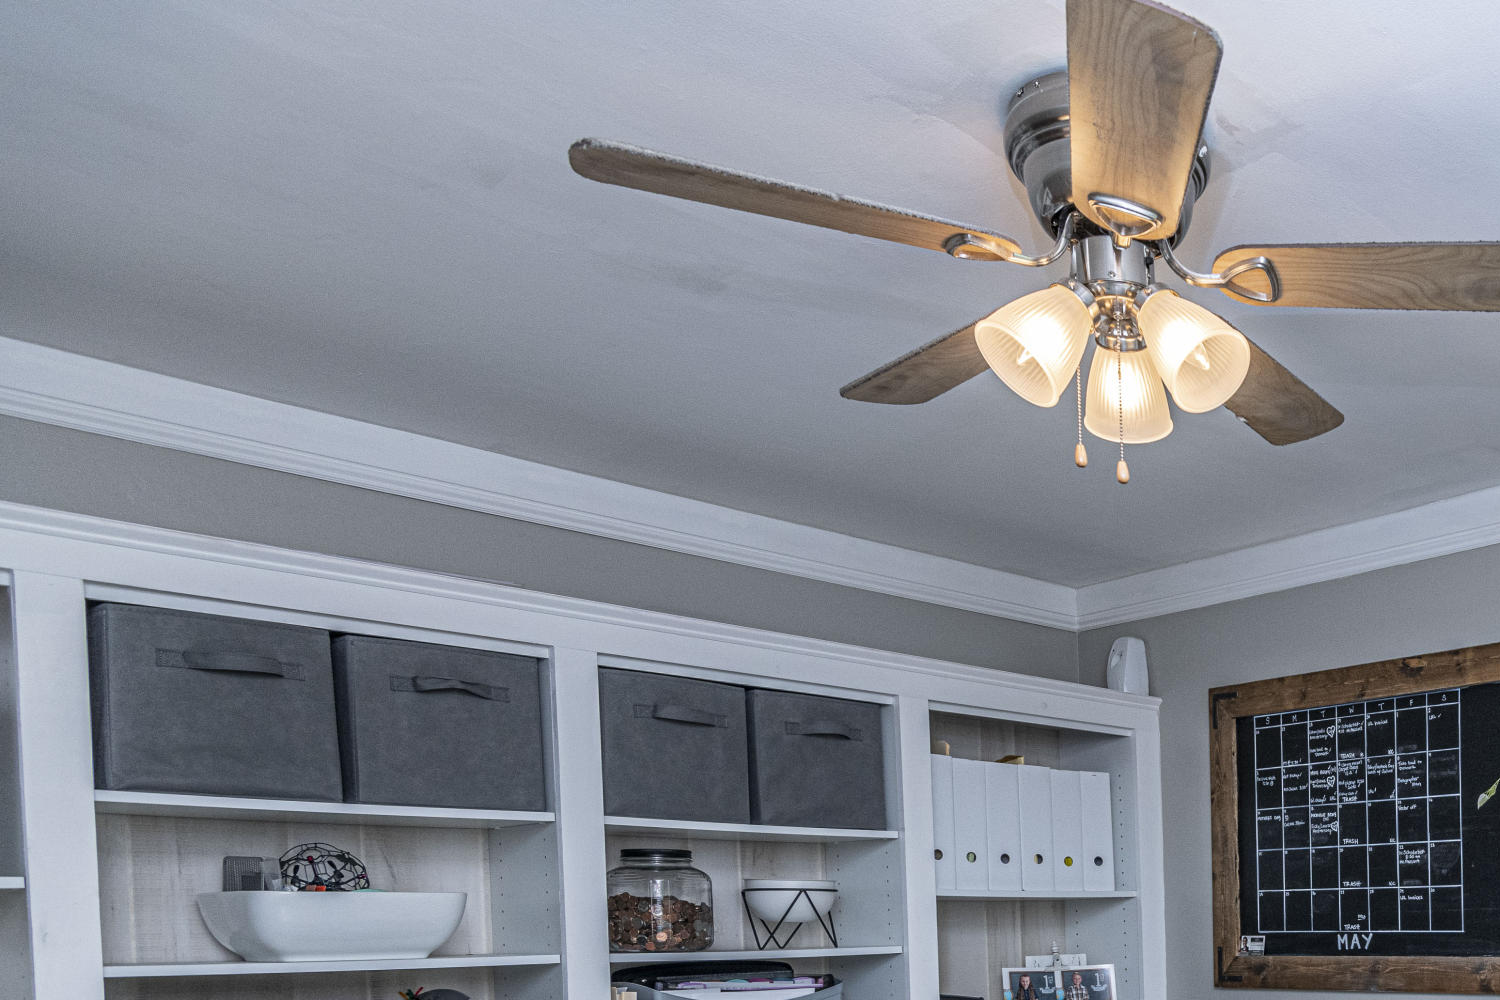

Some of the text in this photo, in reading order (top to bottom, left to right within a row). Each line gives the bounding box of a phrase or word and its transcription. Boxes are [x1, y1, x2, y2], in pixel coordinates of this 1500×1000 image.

[1409, 698, 1414, 706] F
[1442, 694, 1447, 702] S
[1348, 706, 1355, 714] W
[1378, 702, 1385, 710] T
[1292, 714, 1298, 722] M
[1320, 710, 1326, 718] T
[1265, 716, 1271, 725] S
[1337, 933, 1373, 951] MAY
